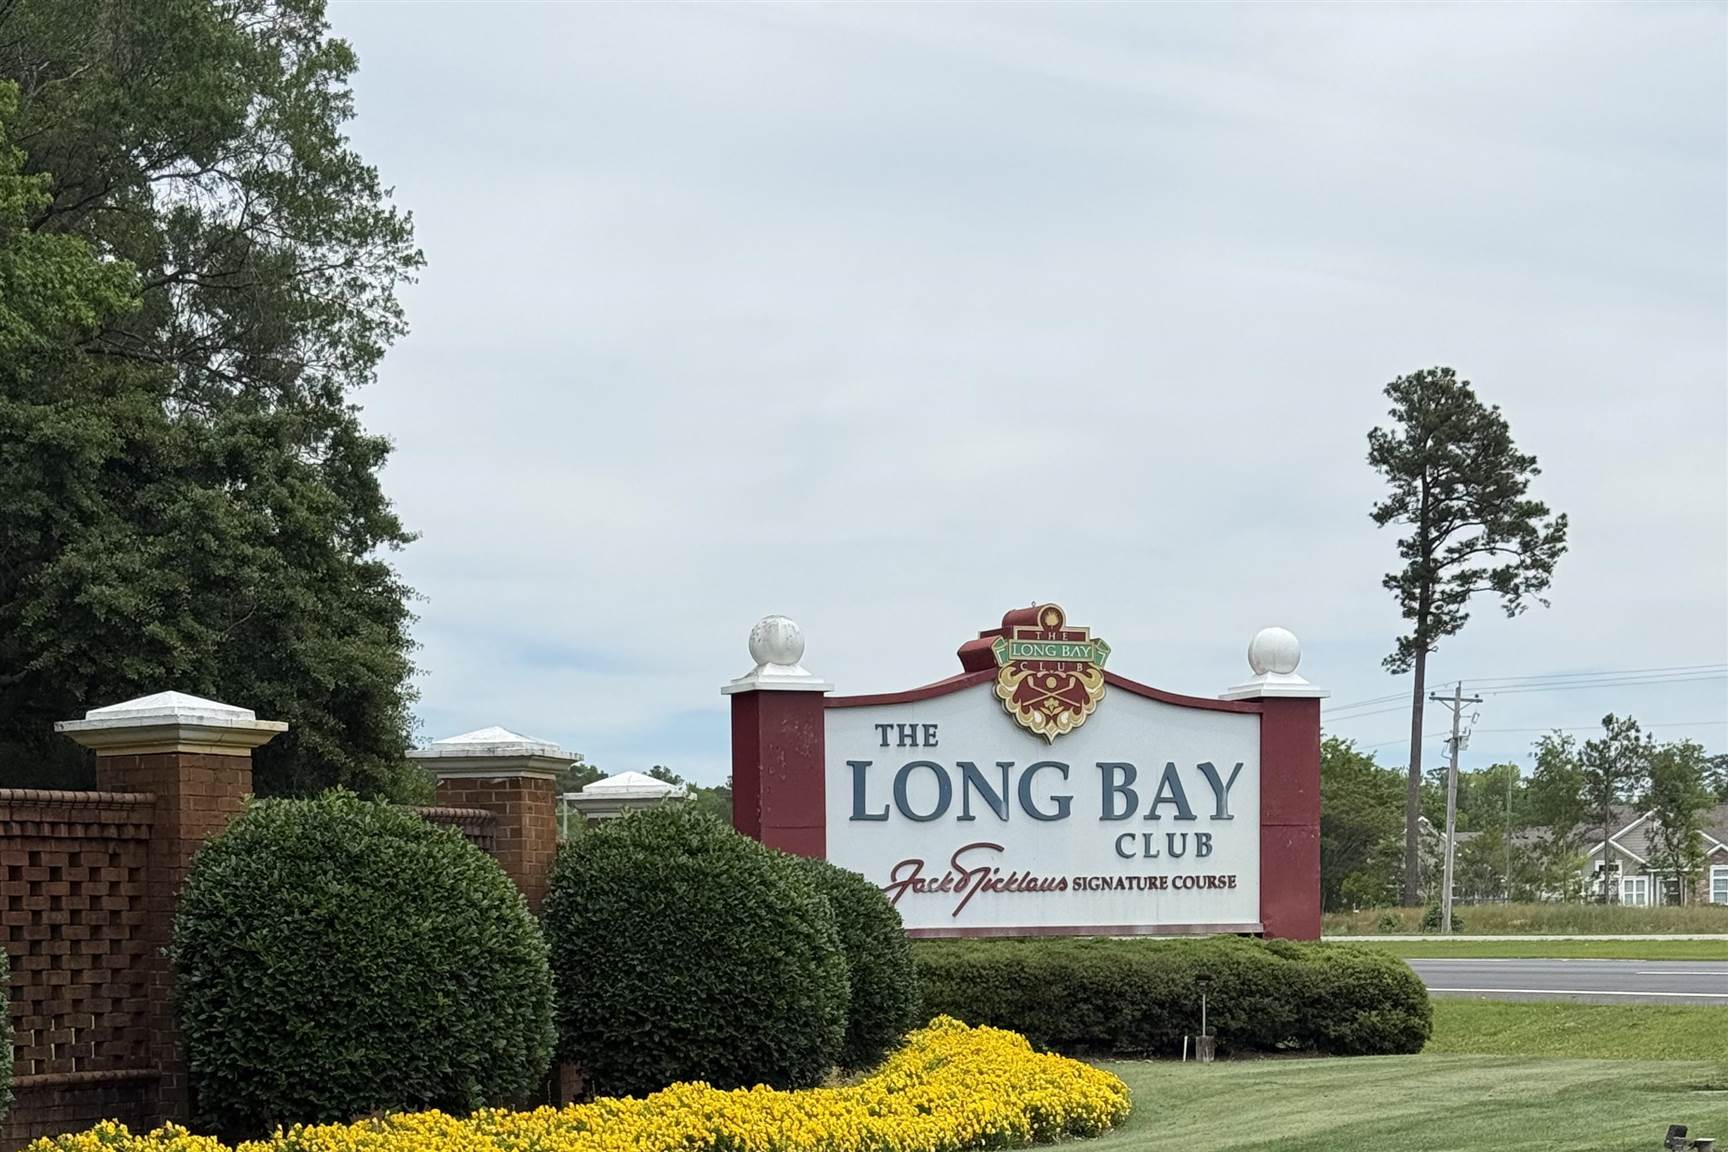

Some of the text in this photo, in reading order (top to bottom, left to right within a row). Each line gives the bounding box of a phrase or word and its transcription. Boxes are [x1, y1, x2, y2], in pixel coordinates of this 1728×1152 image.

[1036, 631, 1069, 641] THE
[1012, 643, 1092, 657] LONG BAY
[1020, 661, 1084, 672] CLUB
[875, 723, 939, 747] THE
[846, 760, 1244, 823] LONG BAY
[1115, 832, 1213, 859] CLUB
[882, 842, 1237, 918] Jack Nicklaus SIGNATURE COURSE
